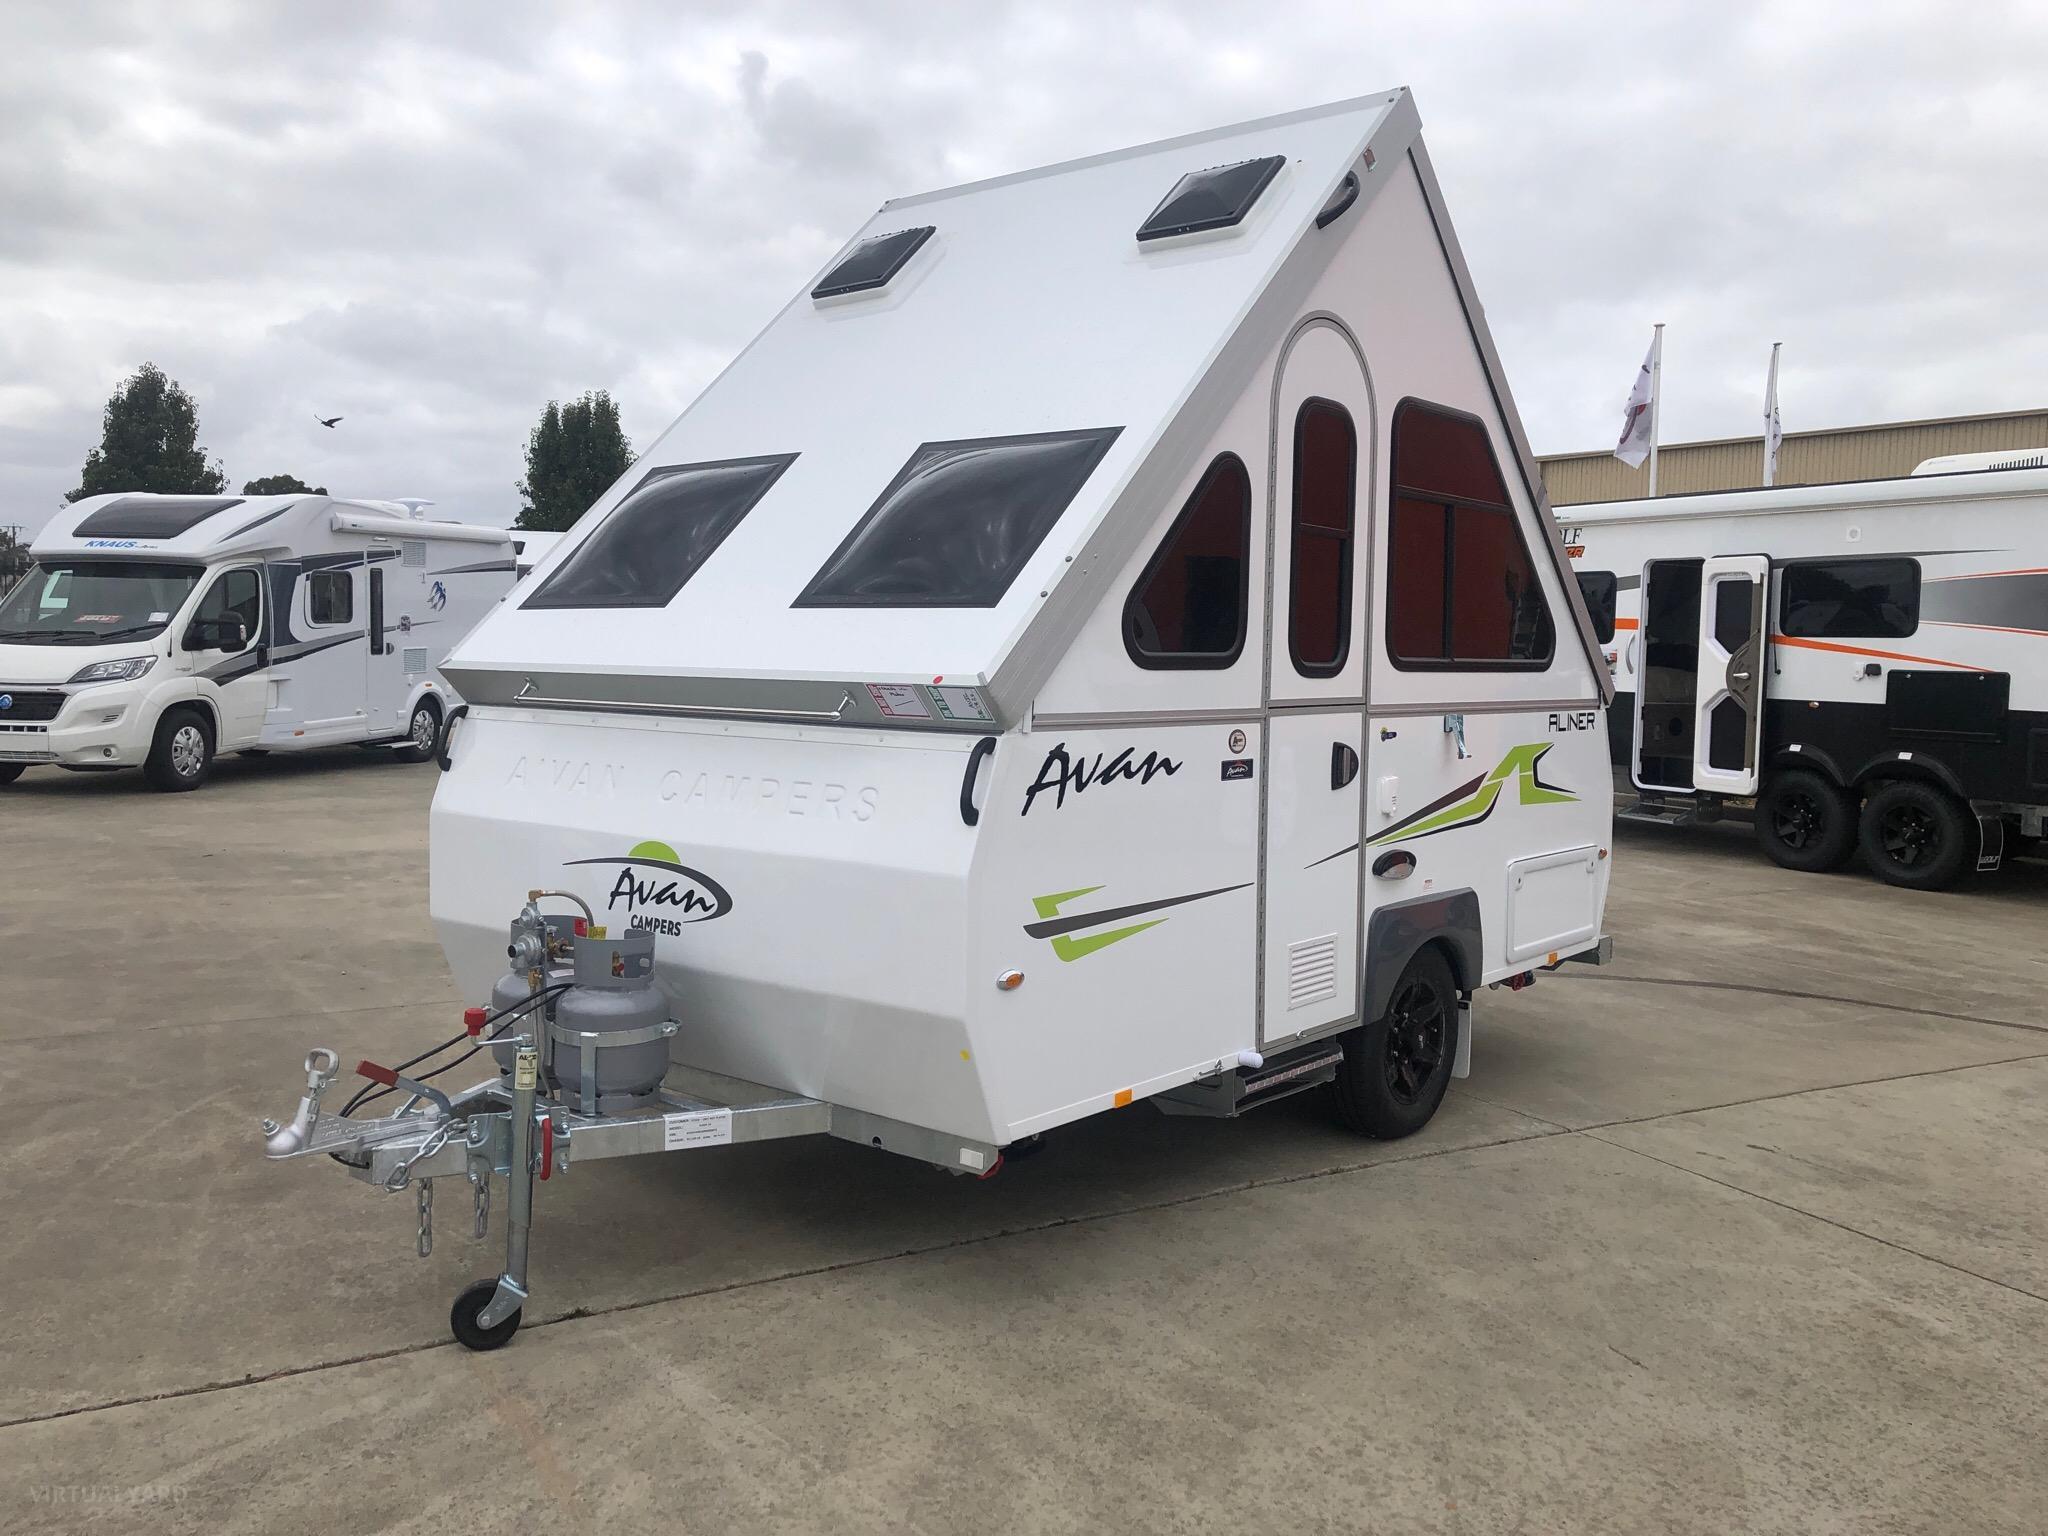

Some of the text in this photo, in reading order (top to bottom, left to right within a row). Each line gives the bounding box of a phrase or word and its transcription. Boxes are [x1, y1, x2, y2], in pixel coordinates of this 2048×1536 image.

[84, 540, 137, 548] KNAUS
[1548, 712, 1596, 733] ALINER
[658, 769, 881, 823] CAMPERS
[1021, 742, 1184, 817] Avan
[608, 866, 716, 913] Avan
[630, 914, 682, 937] CAMPERS
